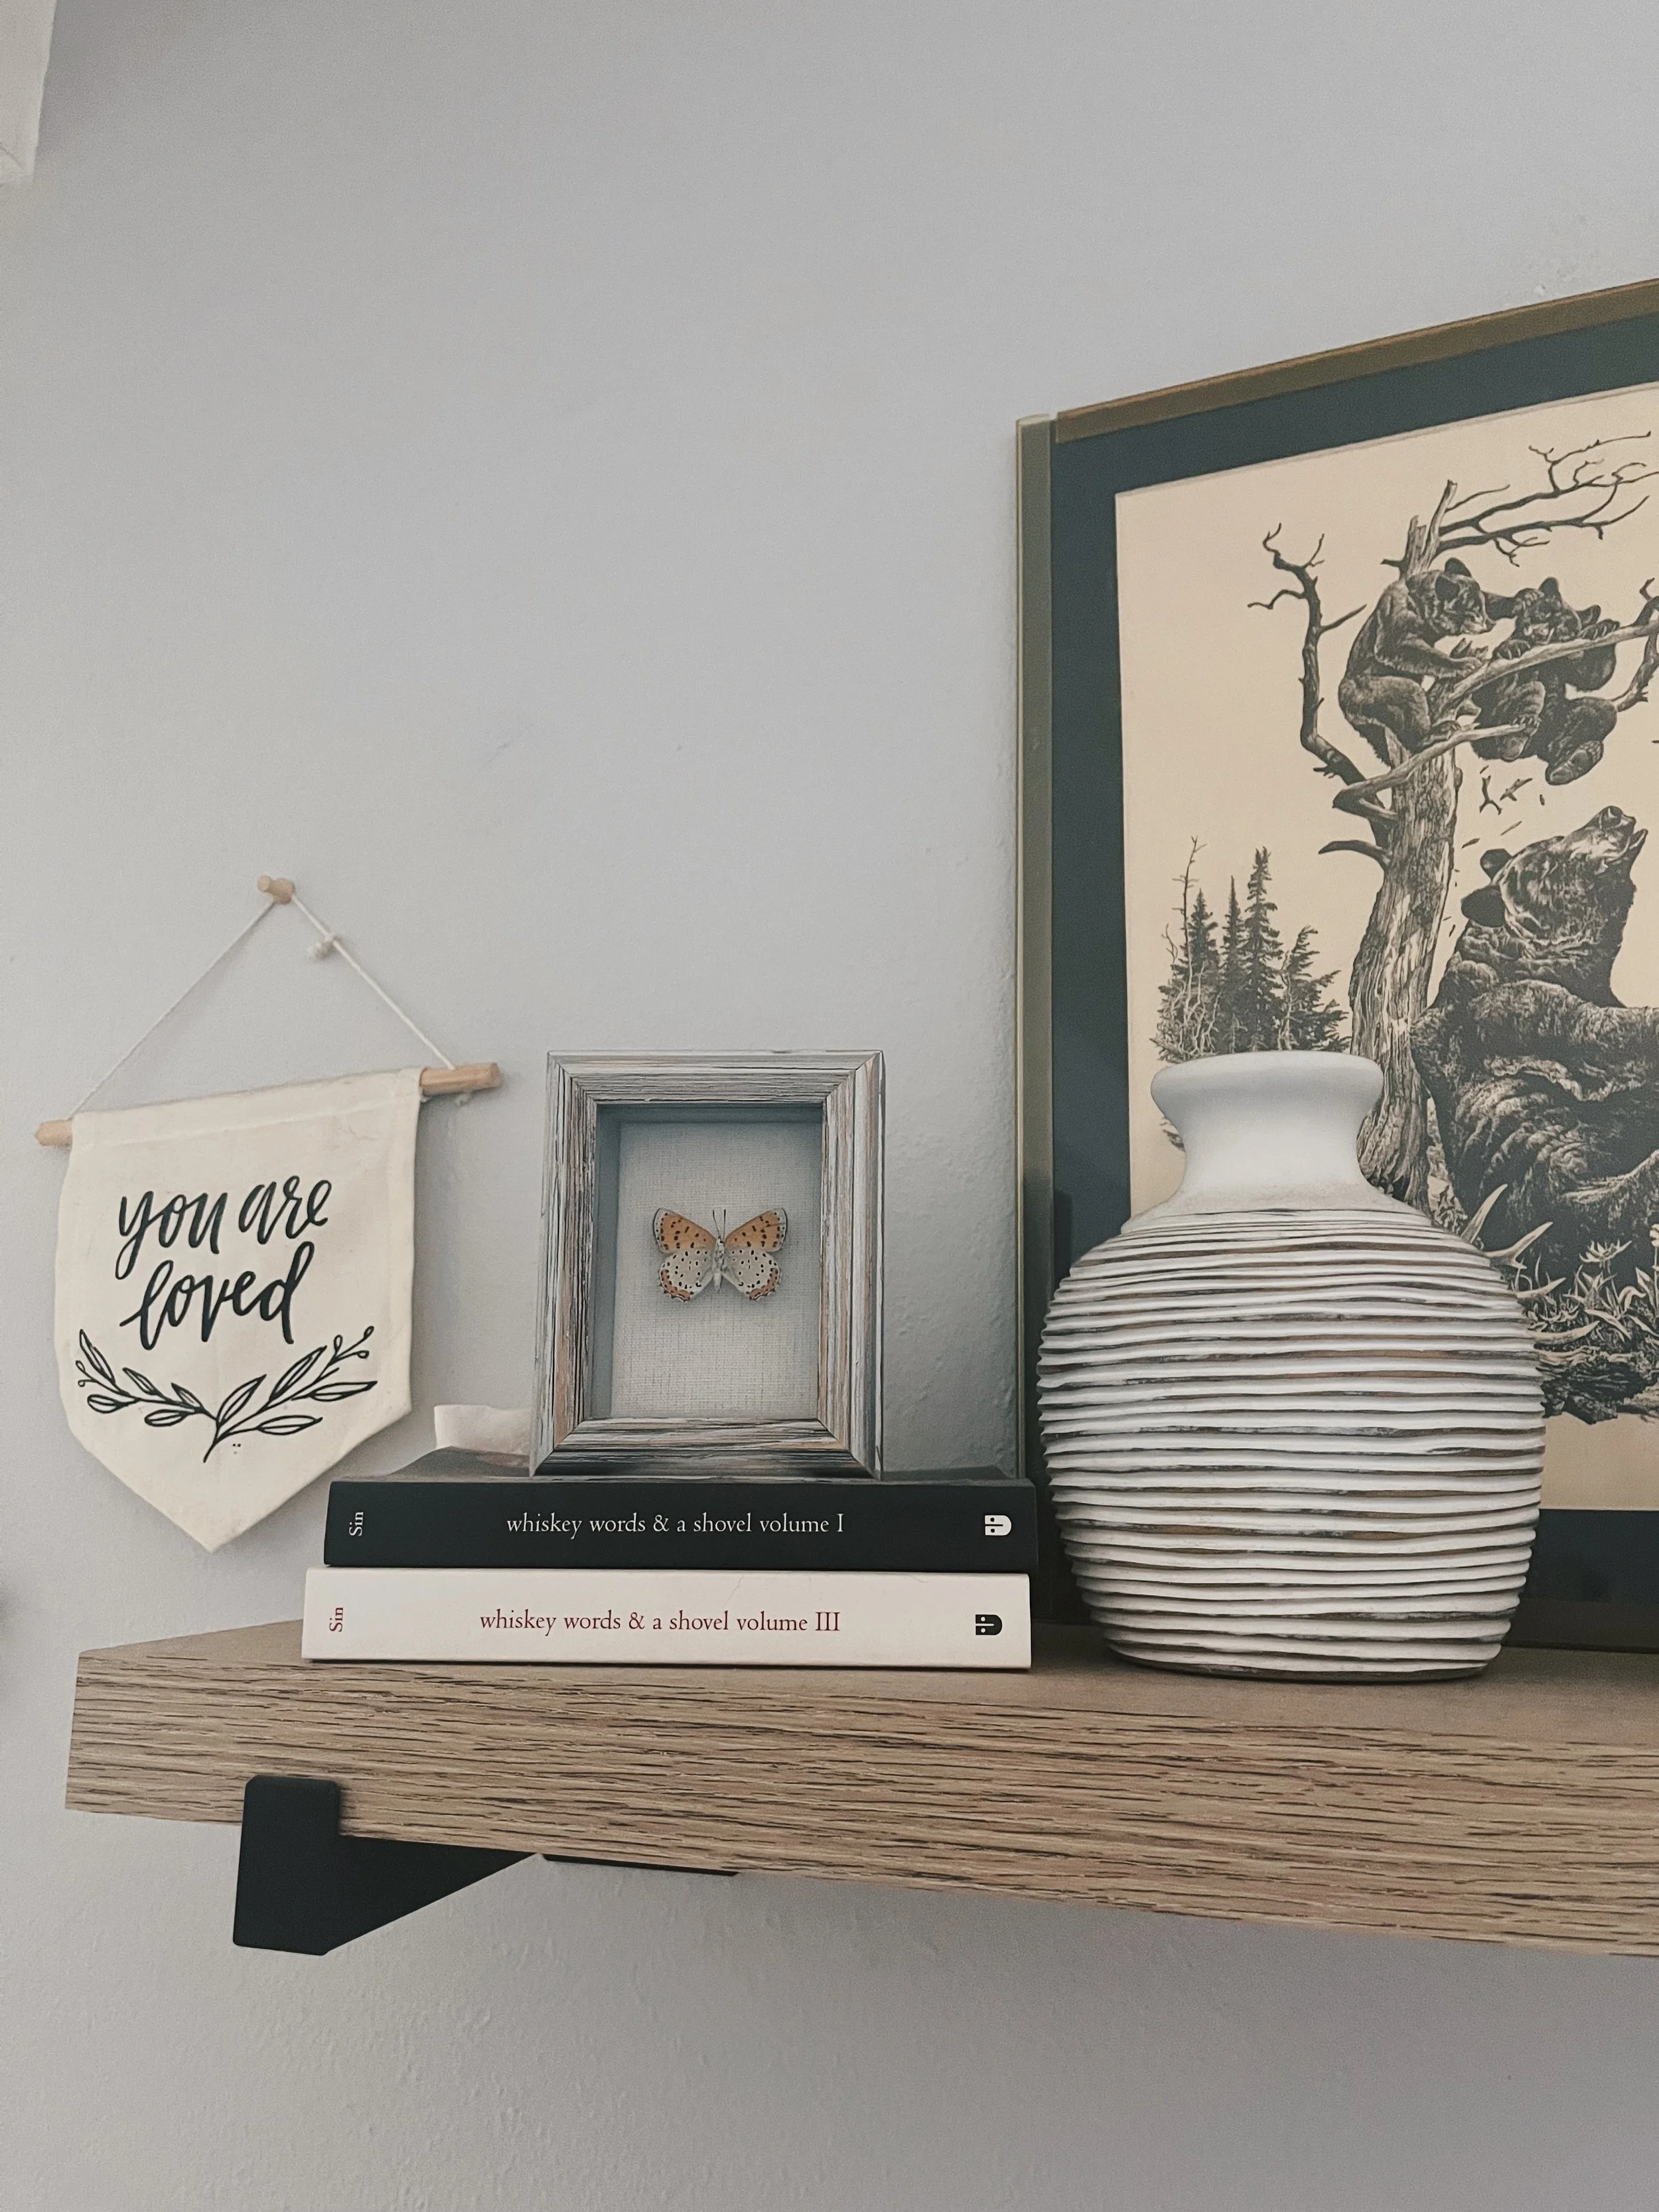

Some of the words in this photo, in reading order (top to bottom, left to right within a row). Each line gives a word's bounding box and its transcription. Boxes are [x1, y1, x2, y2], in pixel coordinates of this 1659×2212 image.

[115, 1190, 228, 1280] you
[238, 1175, 332, 1246] are
[119, 1240, 315, 1351] loved
[348, 1512, 365, 1537] Sin
[507, 1512, 583, 1540] whiskey
[589, 1512, 646, 1533] words
[652, 1514, 671, 1533] &
[677, 1520, 687, 1533] a
[693, 1512, 752, 1533] shovel
[759, 1513, 830, 1533] volume
[837, 1513, 845, 1533] I
[328, 1607, 345, 1633] Sin
[480, 1609, 557, 1637] whiskey
[563, 1609, 622, 1631] words
[628, 1612, 647, 1631] &
[652, 1617, 663, 1631] a
[669, 1610, 729, 1631] shovel
[736, 1611, 809, 1632] volume
[815, 1611, 841, 1632] III
